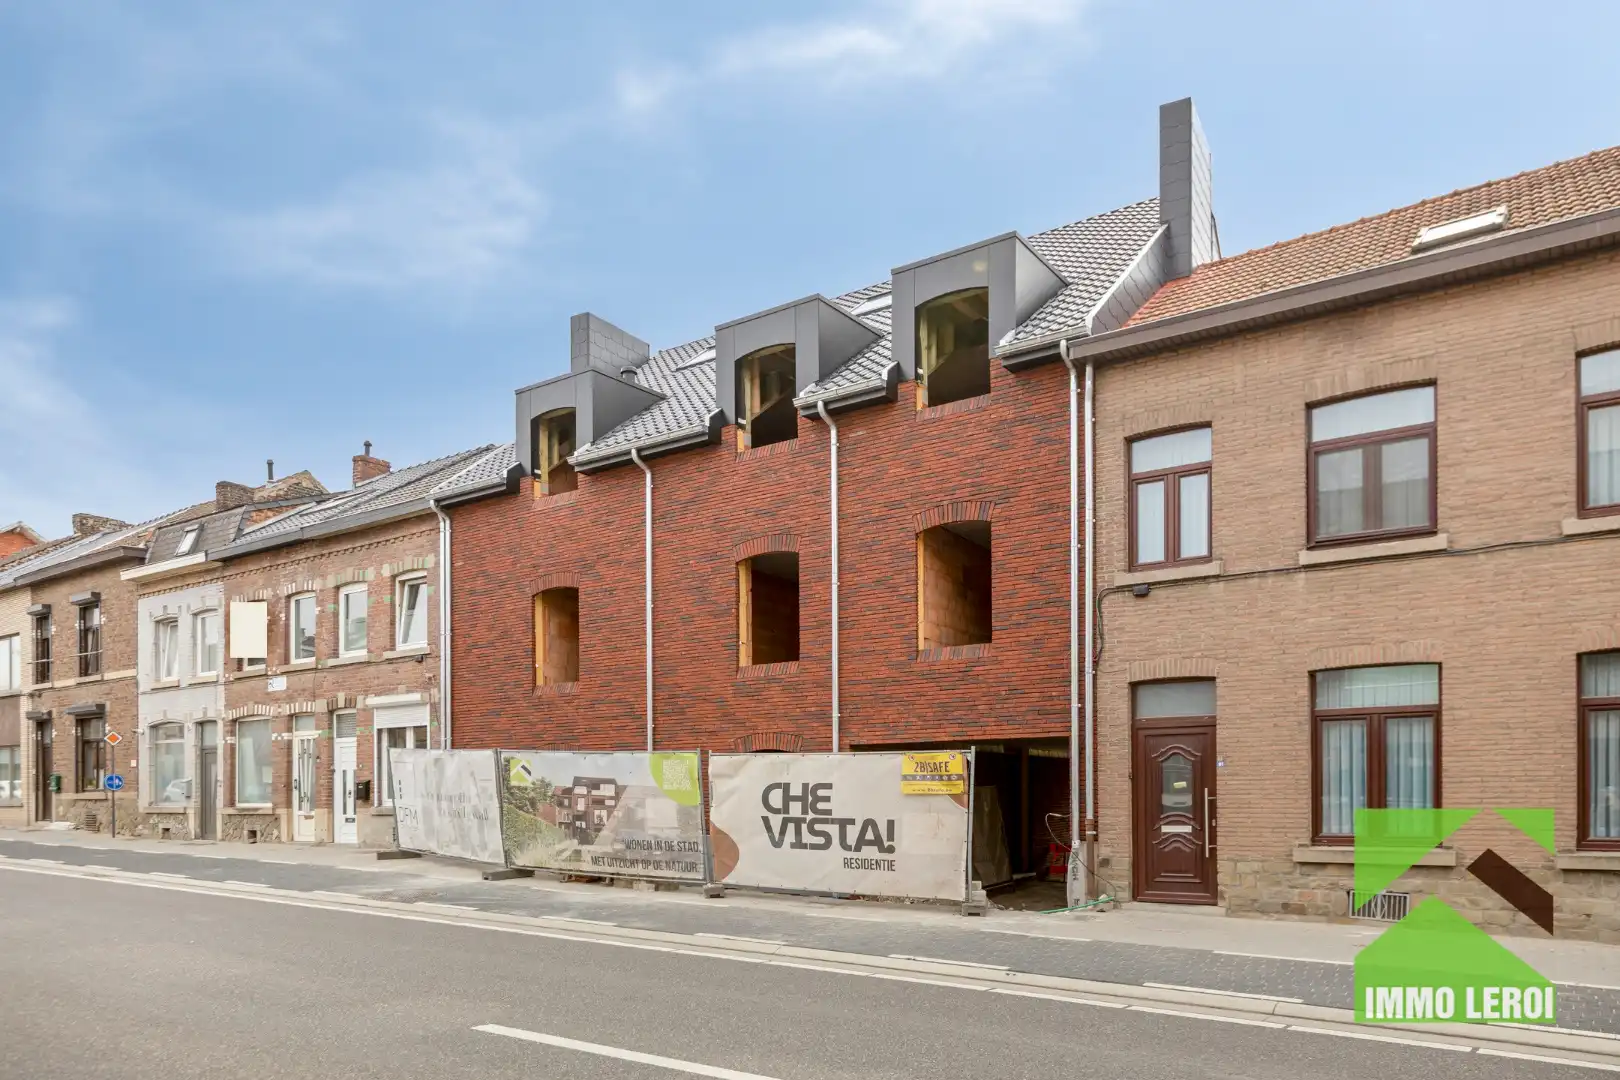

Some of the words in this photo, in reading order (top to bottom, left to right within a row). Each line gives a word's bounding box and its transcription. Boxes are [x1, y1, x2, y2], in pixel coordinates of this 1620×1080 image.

[761, 782, 833, 816] CHE
[761, 815, 896, 854] VISTA!
[624, 839, 653, 851] WONEN
[655, 840, 663, 851] IN
[664, 841, 675, 852] DE
[591, 856, 605, 867] MET
[607, 857, 640, 869] UITZICHT
[641, 859, 651, 870] OP
[653, 860, 663, 871] DE
[843, 857, 896, 872] RESIDENTIE
